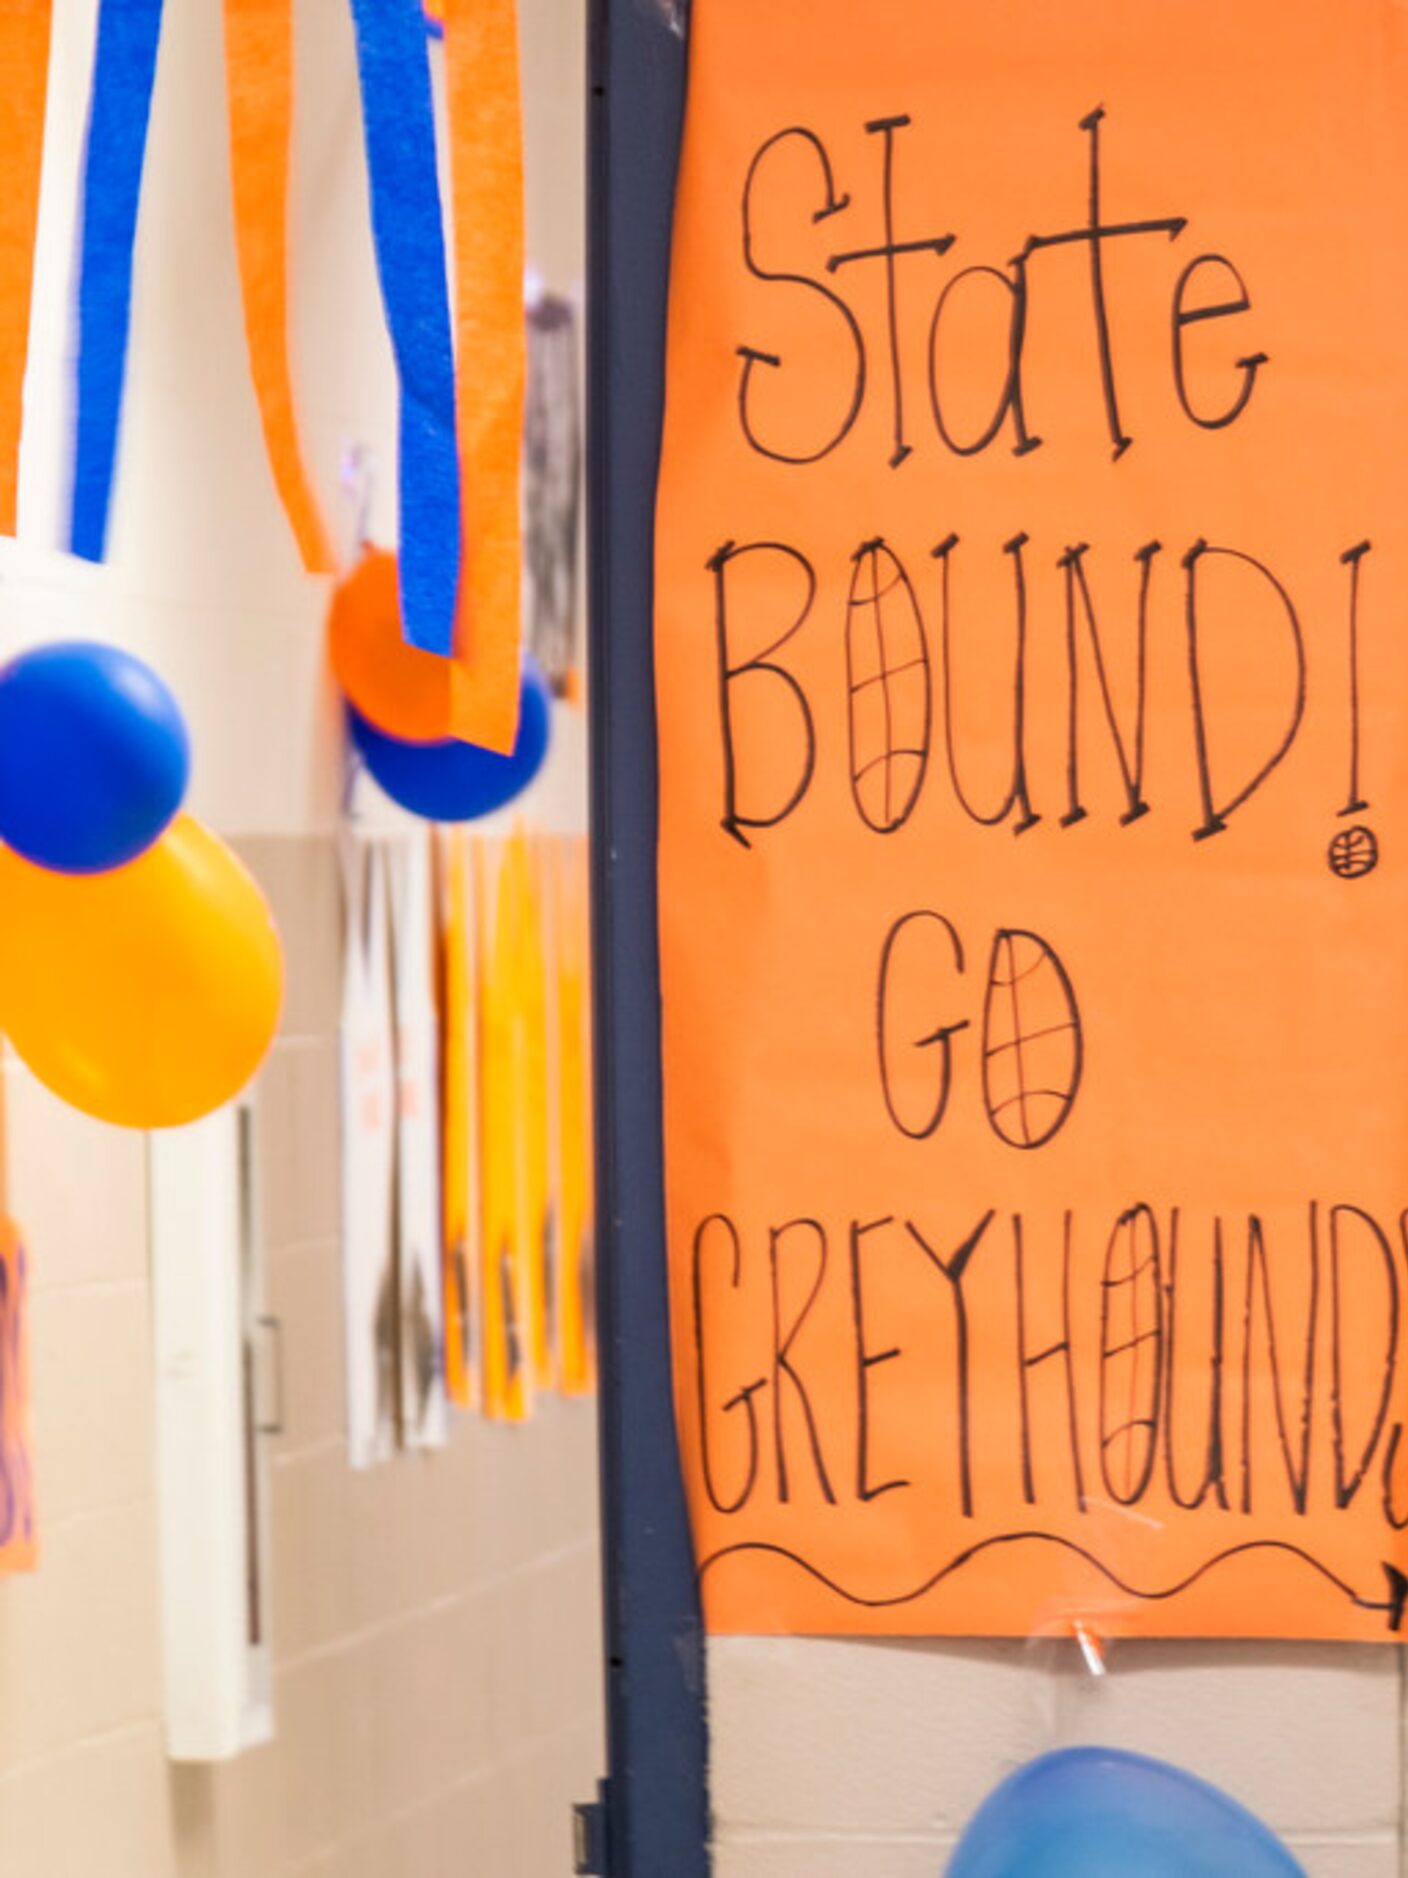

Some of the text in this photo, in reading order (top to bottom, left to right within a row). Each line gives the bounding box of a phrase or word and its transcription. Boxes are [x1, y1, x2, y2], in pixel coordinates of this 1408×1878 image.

[736, 103, 1269, 468] State
[706, 532, 1380, 879] BOUND!
[875, 910, 1084, 1149] GO
